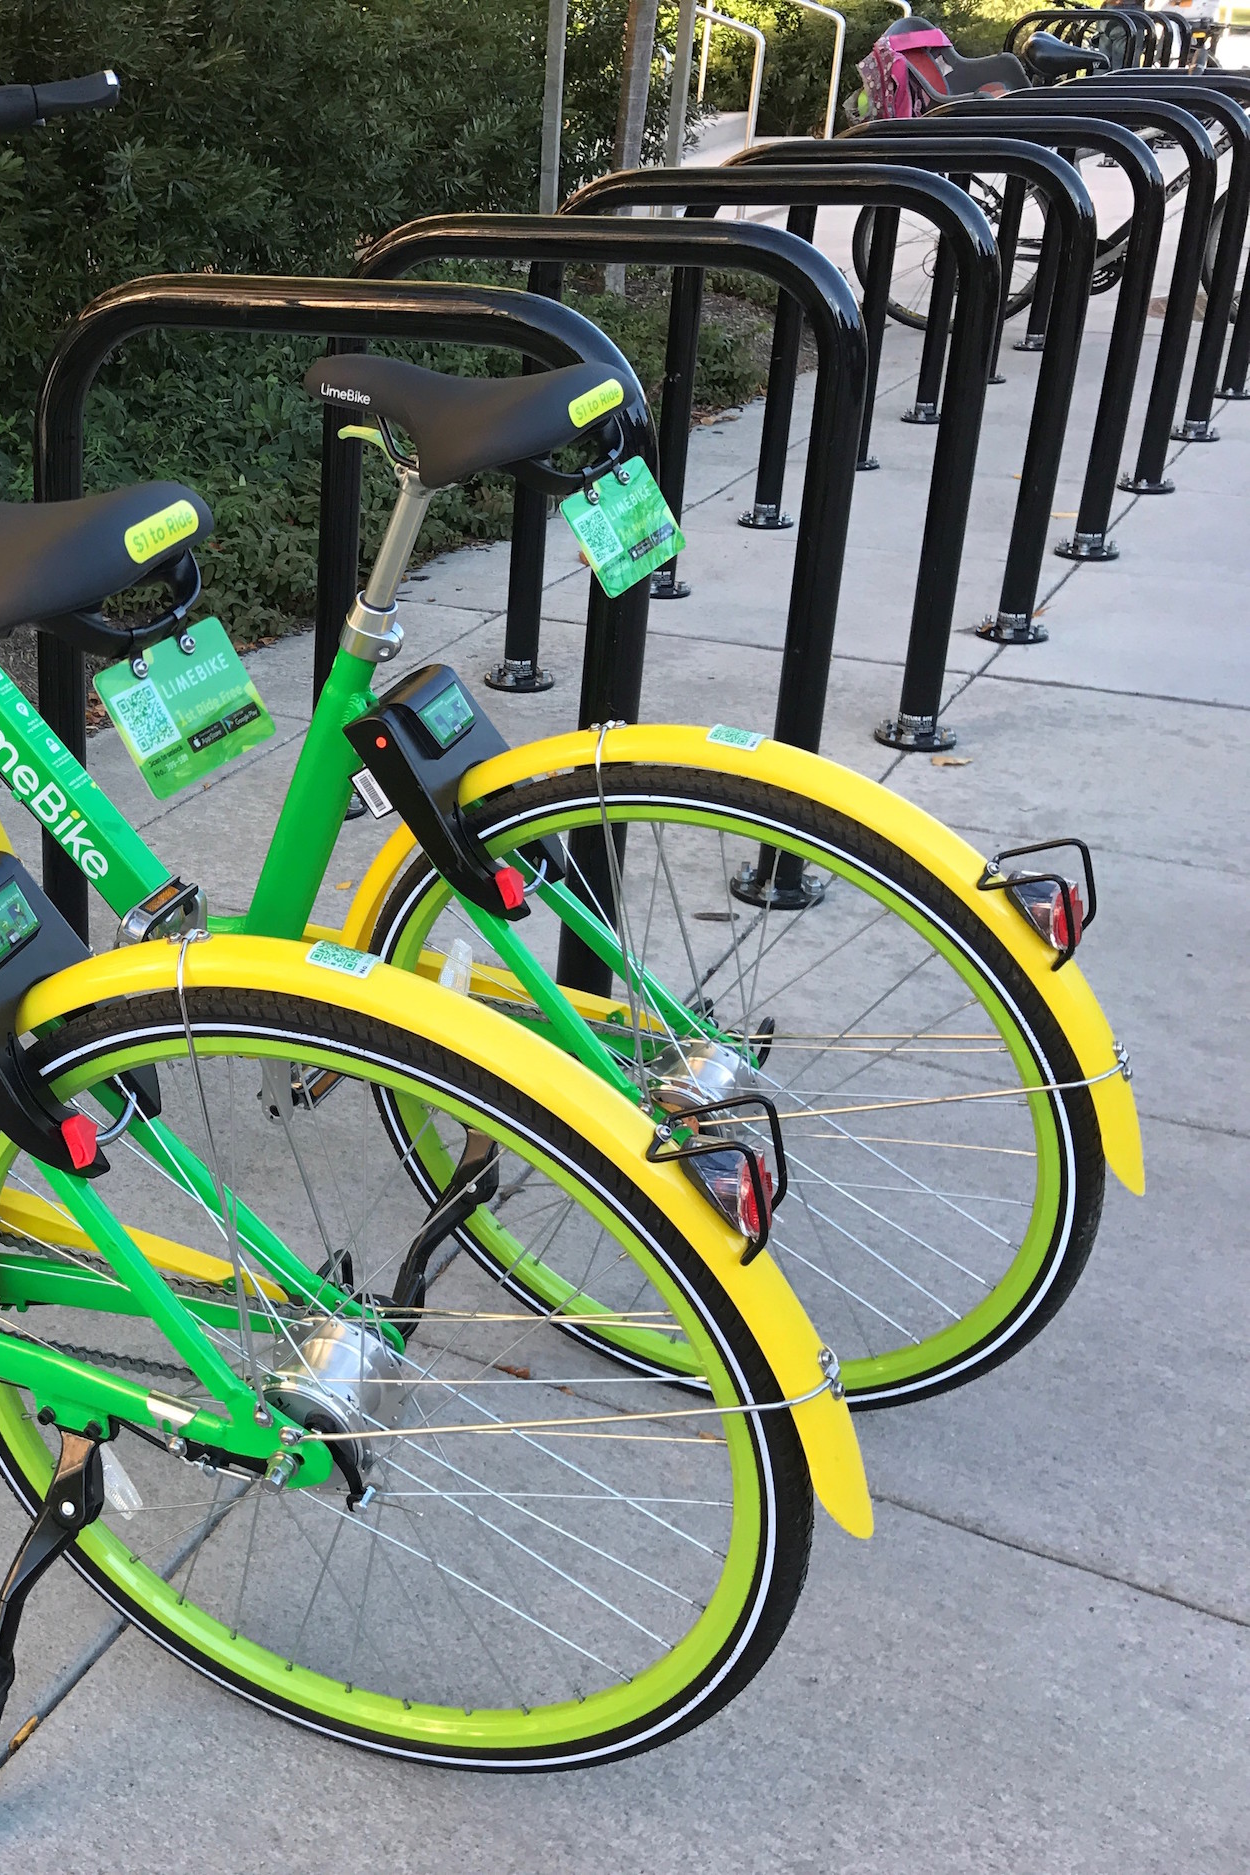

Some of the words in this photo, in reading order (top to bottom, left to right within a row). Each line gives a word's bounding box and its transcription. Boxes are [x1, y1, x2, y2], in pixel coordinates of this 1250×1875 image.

[320, 382, 370, 405] LimeBike
[575, 404, 588, 420] $1
[587, 399, 598, 414] to
[599, 386, 620, 412] Ride
[608, 486, 651, 519] LIMEBIKE
[133, 533, 149, 554] $1
[149, 524, 166, 546] to
[167, 508, 193, 539] Ride
[161, 653, 229, 699] LIMEBIKE
[177, 706, 197, 727] 1st
[196, 696, 221, 717] Ride
[219, 684, 244, 705] Free
